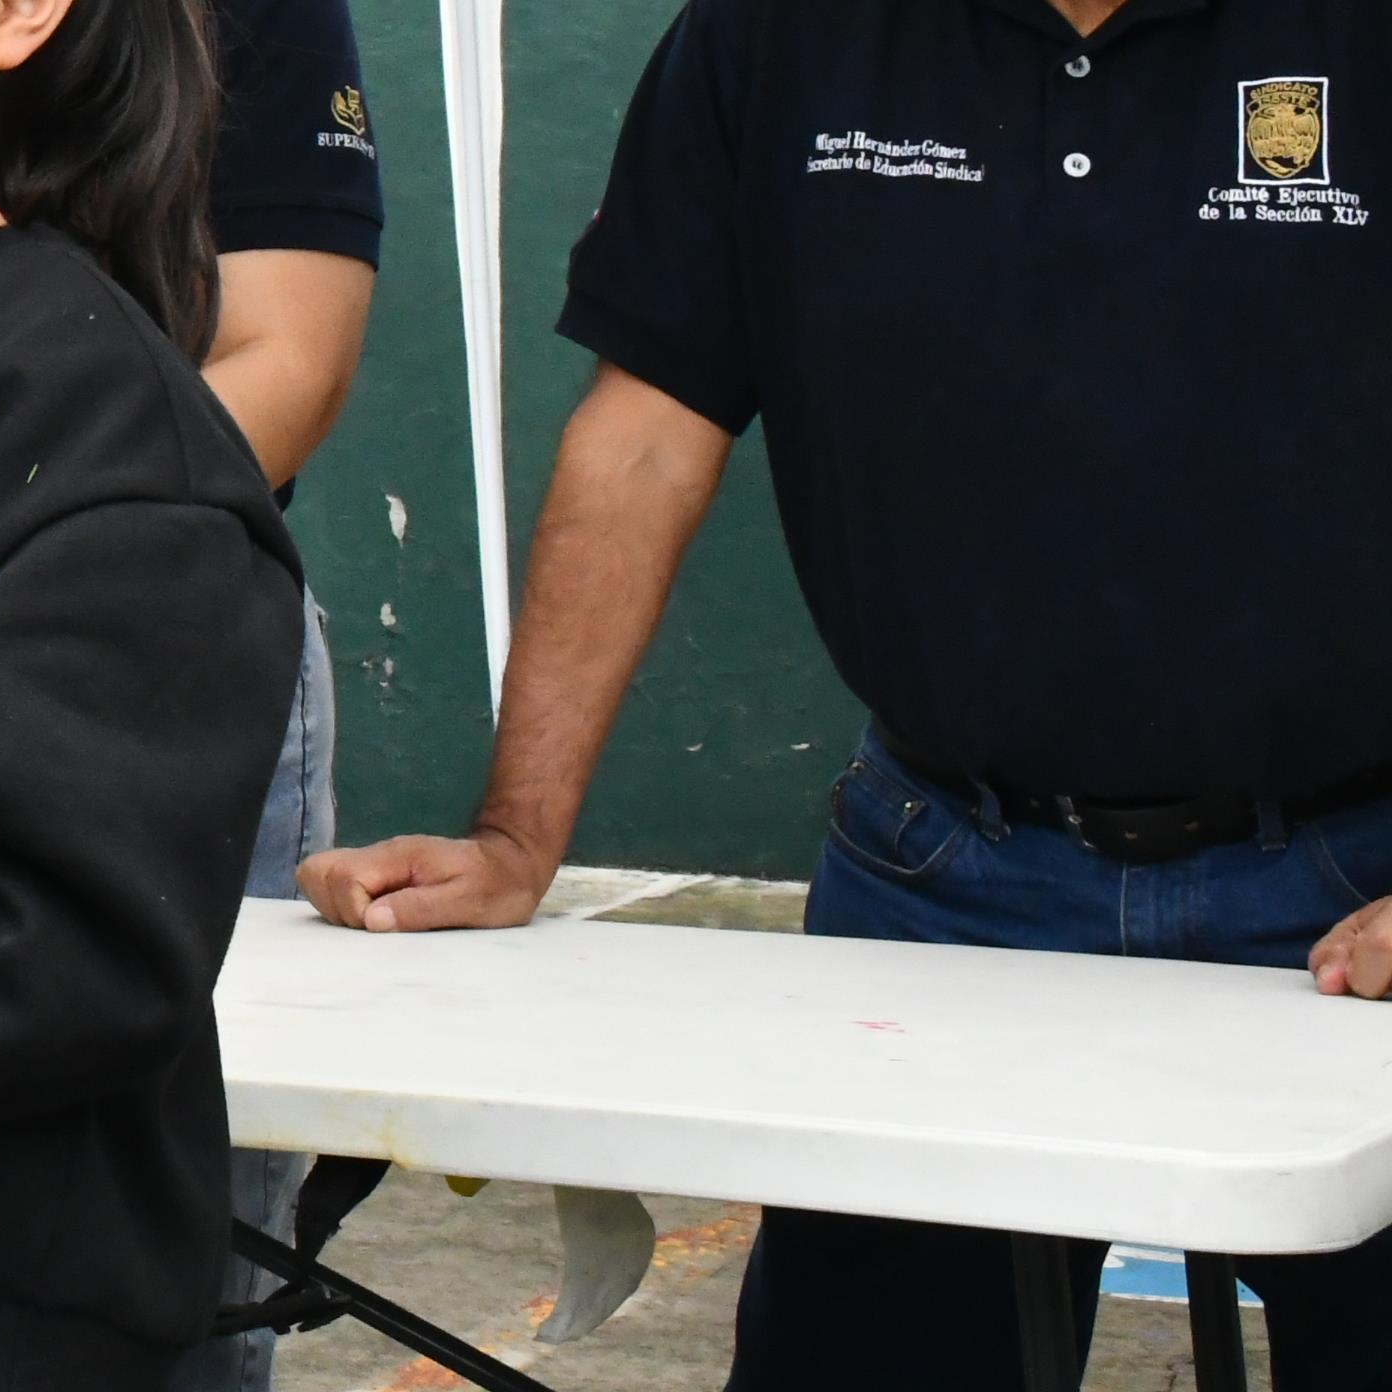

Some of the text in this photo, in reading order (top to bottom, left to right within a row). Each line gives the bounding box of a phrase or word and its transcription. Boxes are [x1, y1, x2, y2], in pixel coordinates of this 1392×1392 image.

[1250, 82, 1318, 100] SINDICATO
[816, 131, 966, 159] Miguel Hernández Gómez
[855, 152, 871, 170] de
[872, 156, 934, 177] Educación
[1208, 186, 1360, 206] Comité Ejecutivo
[1199, 204, 1369, 226] de la Sección XLV
